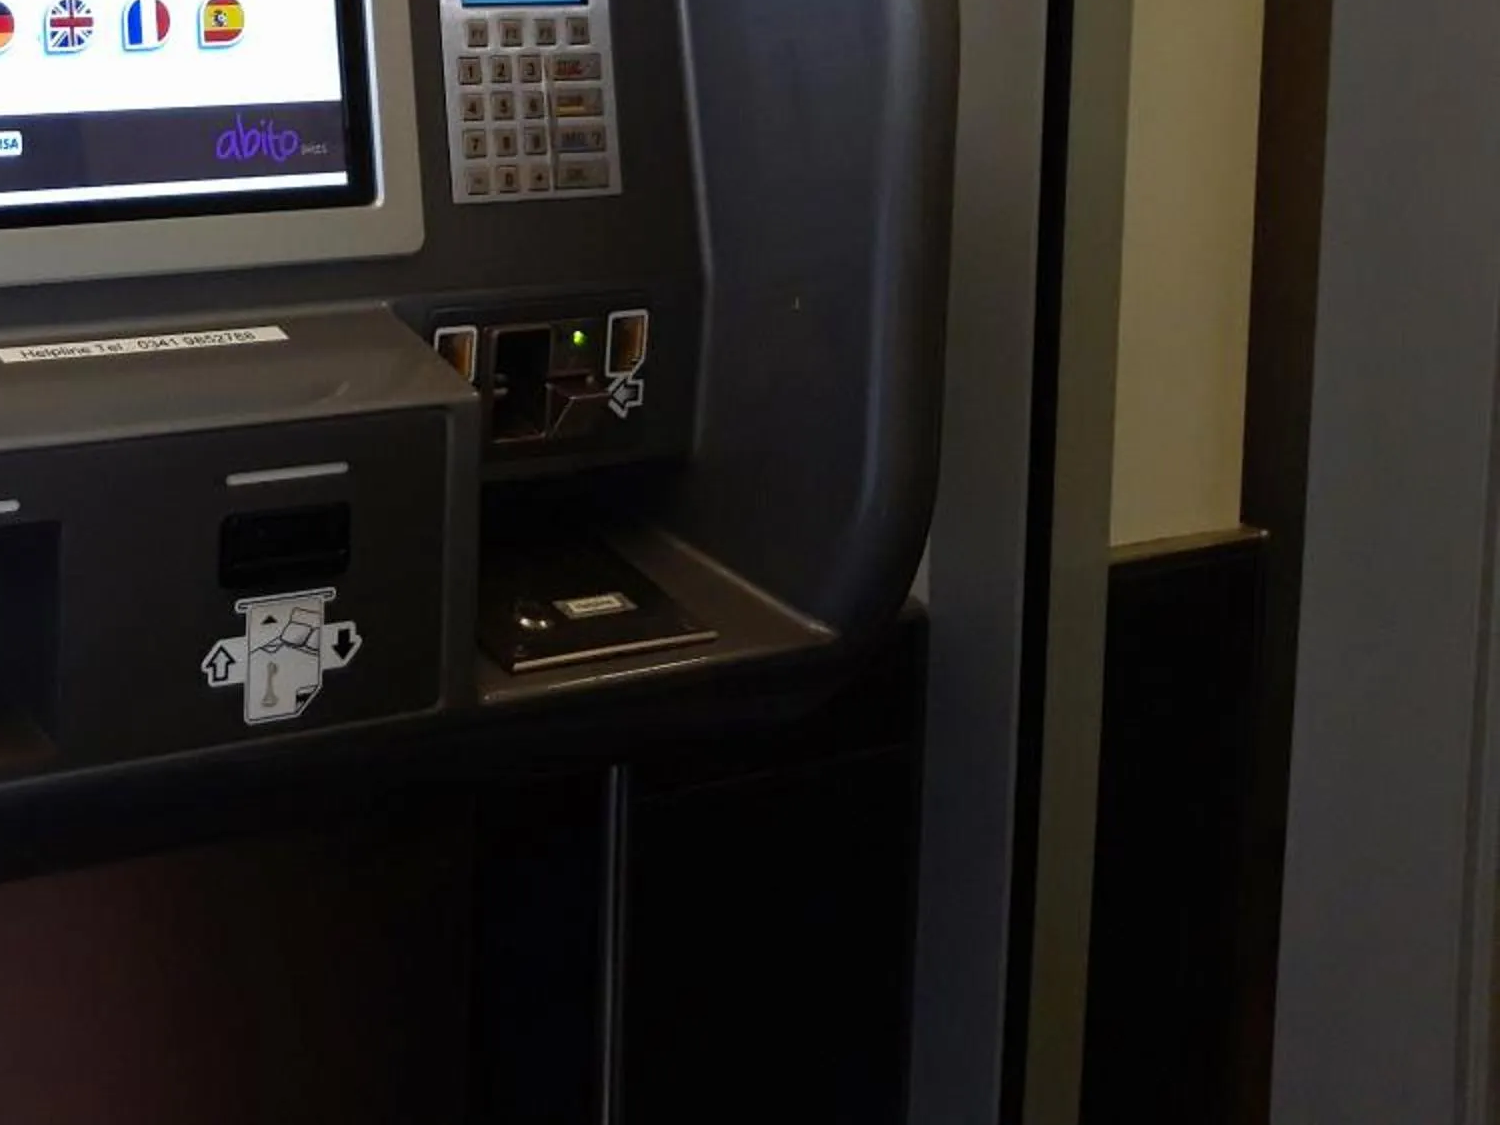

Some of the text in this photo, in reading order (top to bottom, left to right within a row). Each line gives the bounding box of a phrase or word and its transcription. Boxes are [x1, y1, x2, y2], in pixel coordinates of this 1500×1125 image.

[216, 112, 300, 163] abito
[19, 344, 91, 360] Helpline
[136, 336, 178, 351] 0341
